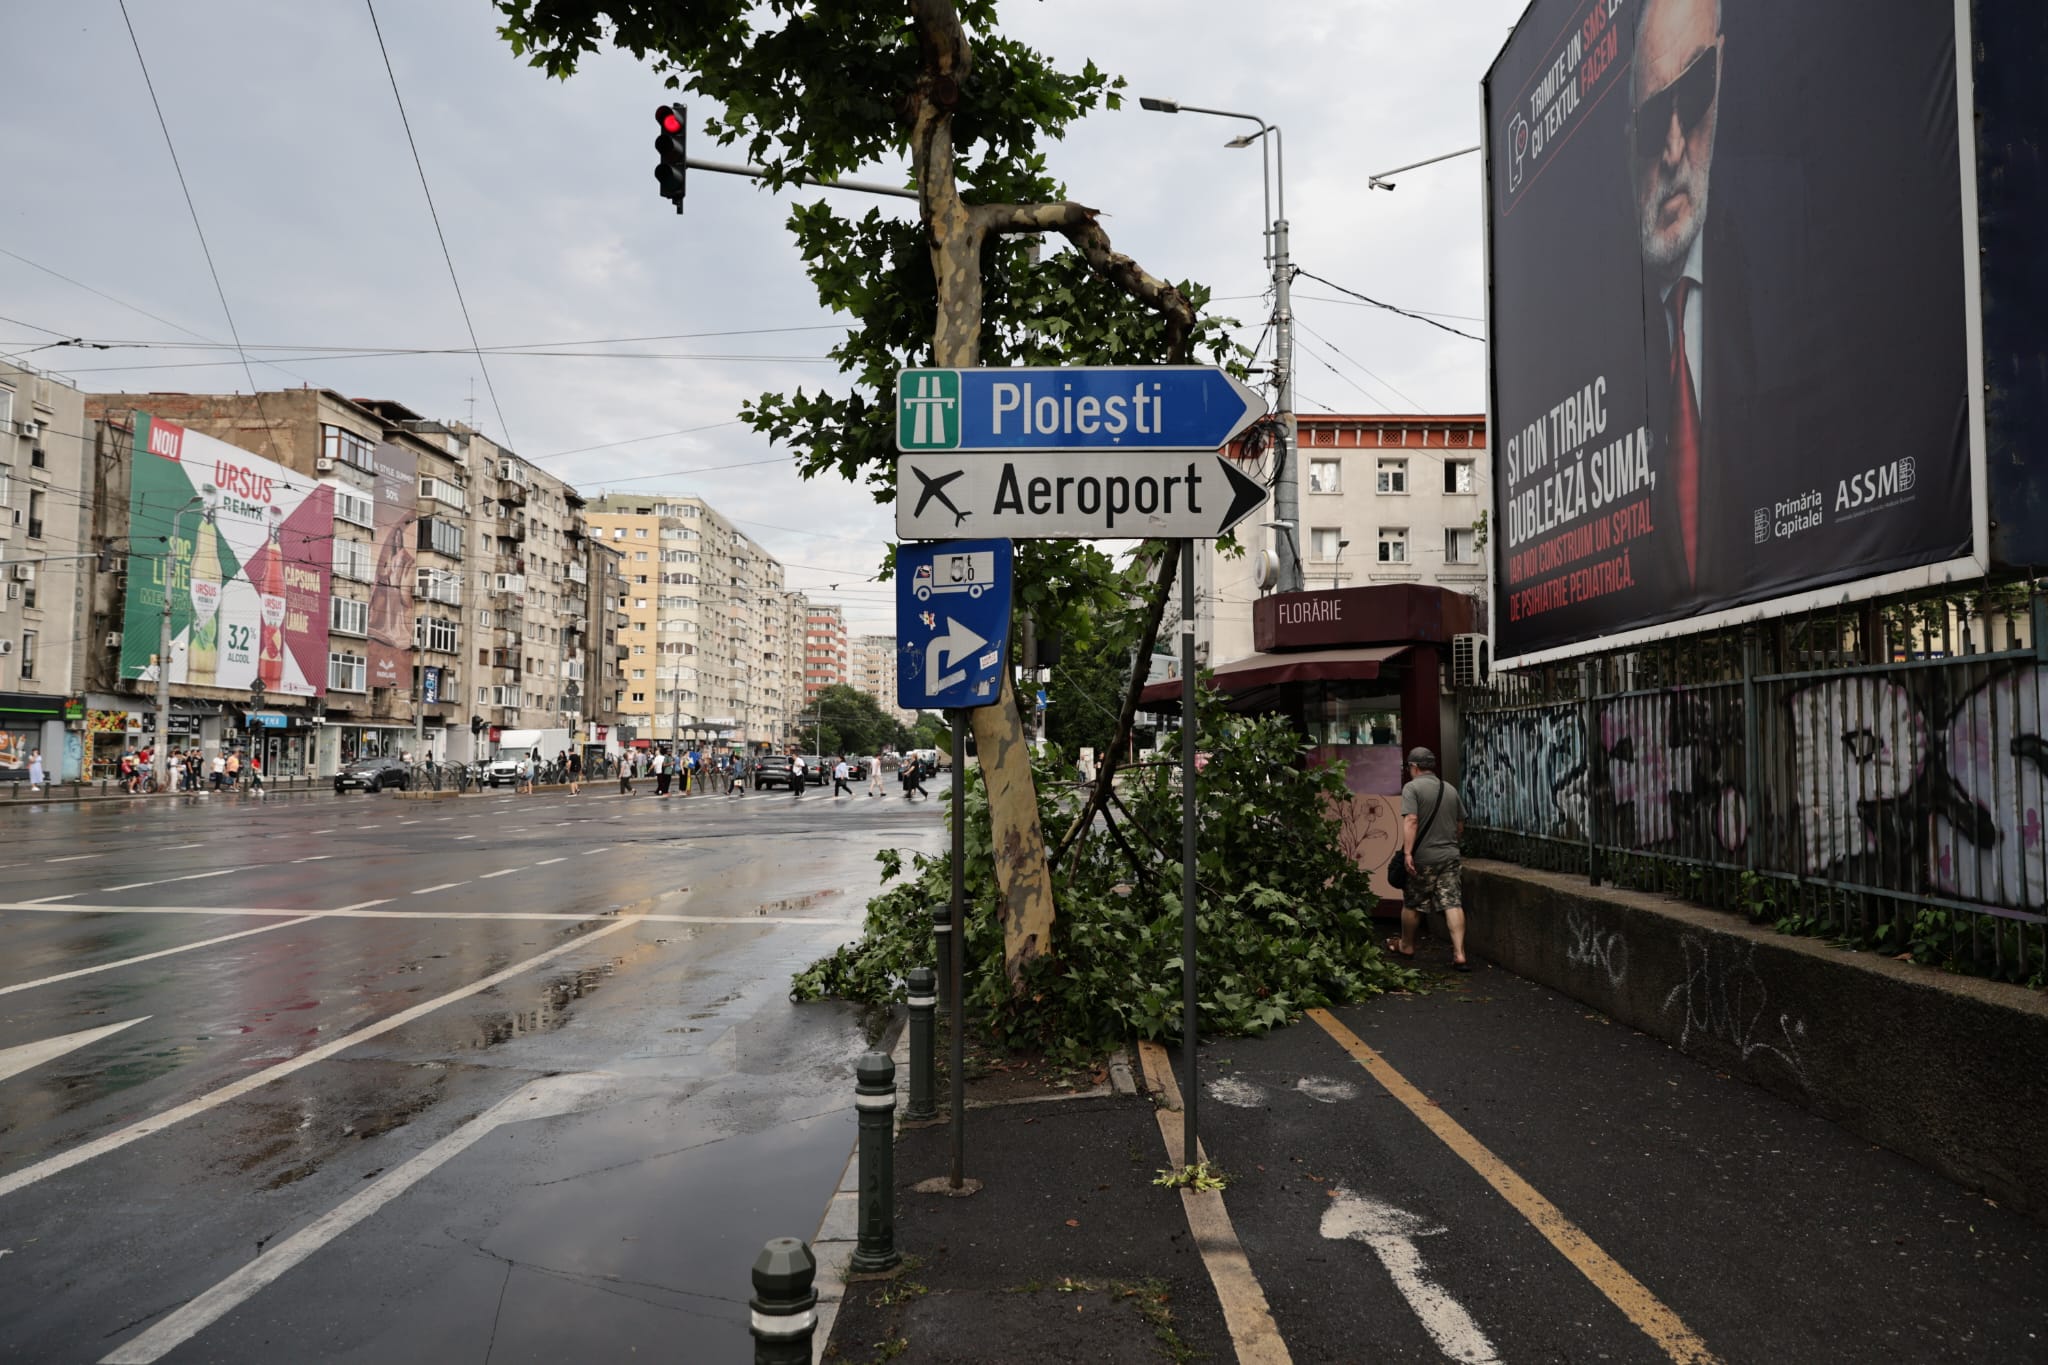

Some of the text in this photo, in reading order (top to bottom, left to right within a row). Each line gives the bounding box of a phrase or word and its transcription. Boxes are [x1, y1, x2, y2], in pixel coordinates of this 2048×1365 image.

[1530, 0, 1623, 122] TRIMITE UN SMS L
[1531, 23, 1618, 160] CU TEXTUL FACEM
[992, 382, 1162, 445] Ploiești
[1522, 414, 1547, 478] ION
[1550, 375, 1607, 472] ȚIRIAC
[151, 427, 179, 458] NOU
[214, 459, 273, 504] URSUS
[223, 496, 264, 521] REMIX
[992, 462, 1203, 529] Aeroport
[1508, 425, 1656, 548] DUBLEAZĂ SUMA,
[1775, 489, 1823, 519] Primăria
[168, 535, 191, 562] SOC
[1509, 497, 1654, 585] IAR NOI CONSTRUIM UN SPITAL
[1774, 506, 1823, 539] Capitalei
[1279, 598, 1343, 625] FLORĂRIE
[1509, 547, 1635, 622] DE PSIHIATRIE PEDIATRICĂ.
[227, 652, 250, 665] ALCOOL
